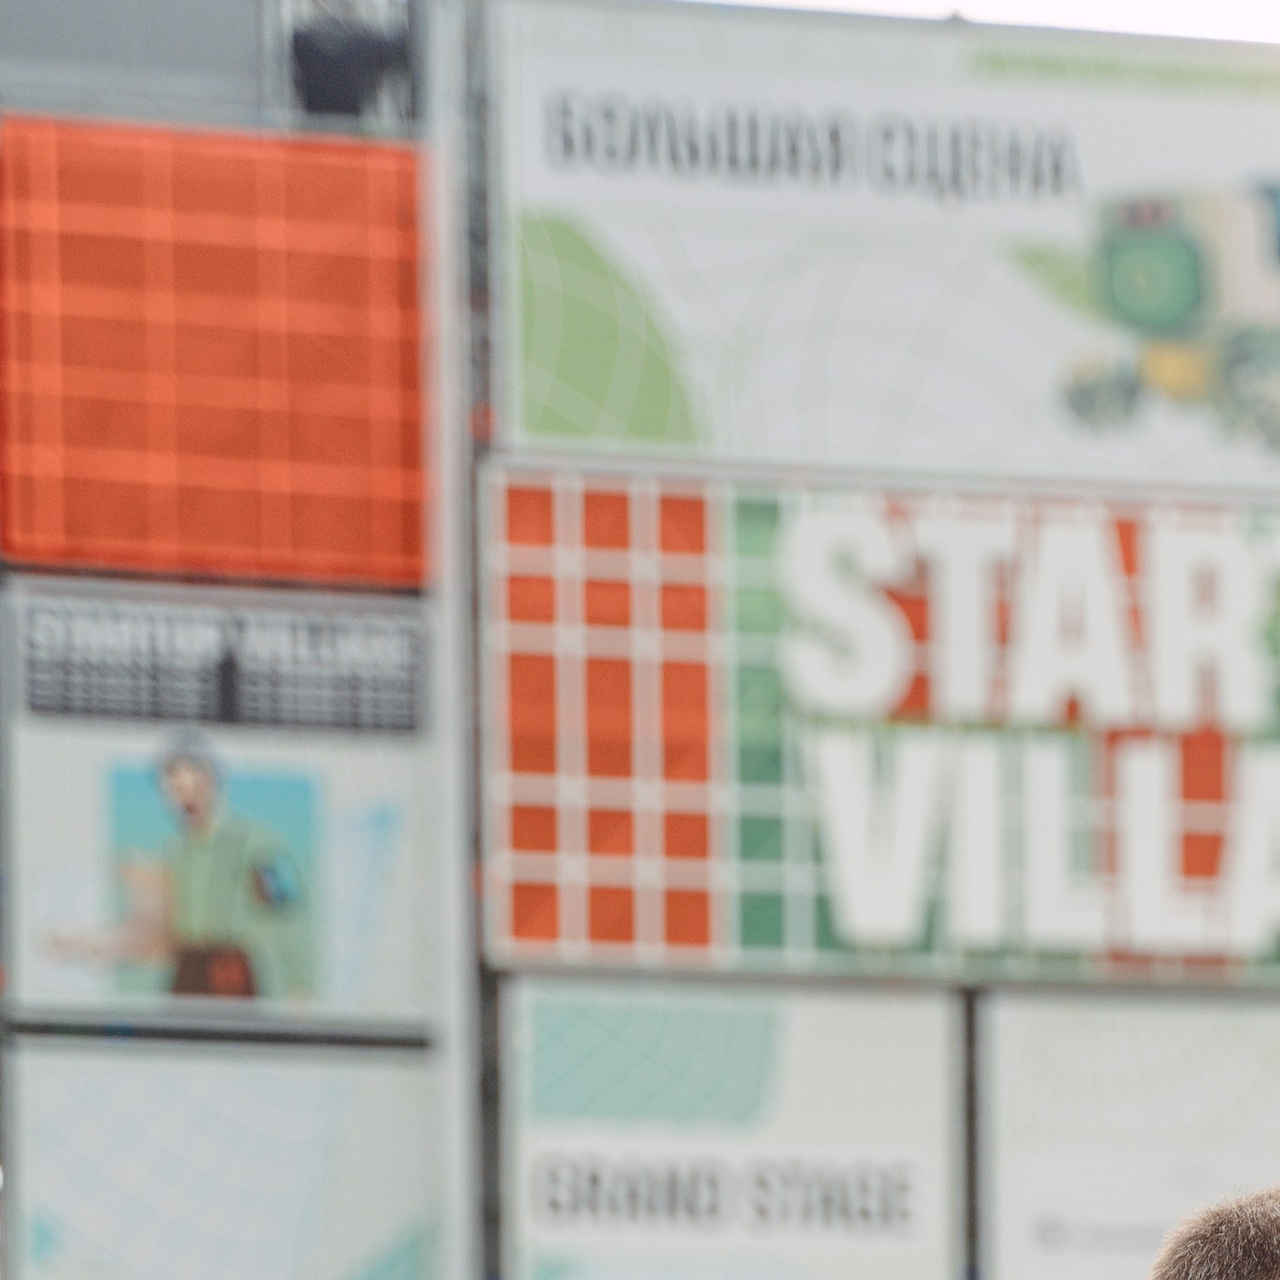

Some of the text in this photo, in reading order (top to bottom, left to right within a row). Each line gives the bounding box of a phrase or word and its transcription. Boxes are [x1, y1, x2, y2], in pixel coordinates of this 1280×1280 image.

[545, 95, 1083, 205] БОЛЬШАЯ СЦЕНА
[545, 1158, 914, 1236] GRAND STAGE
